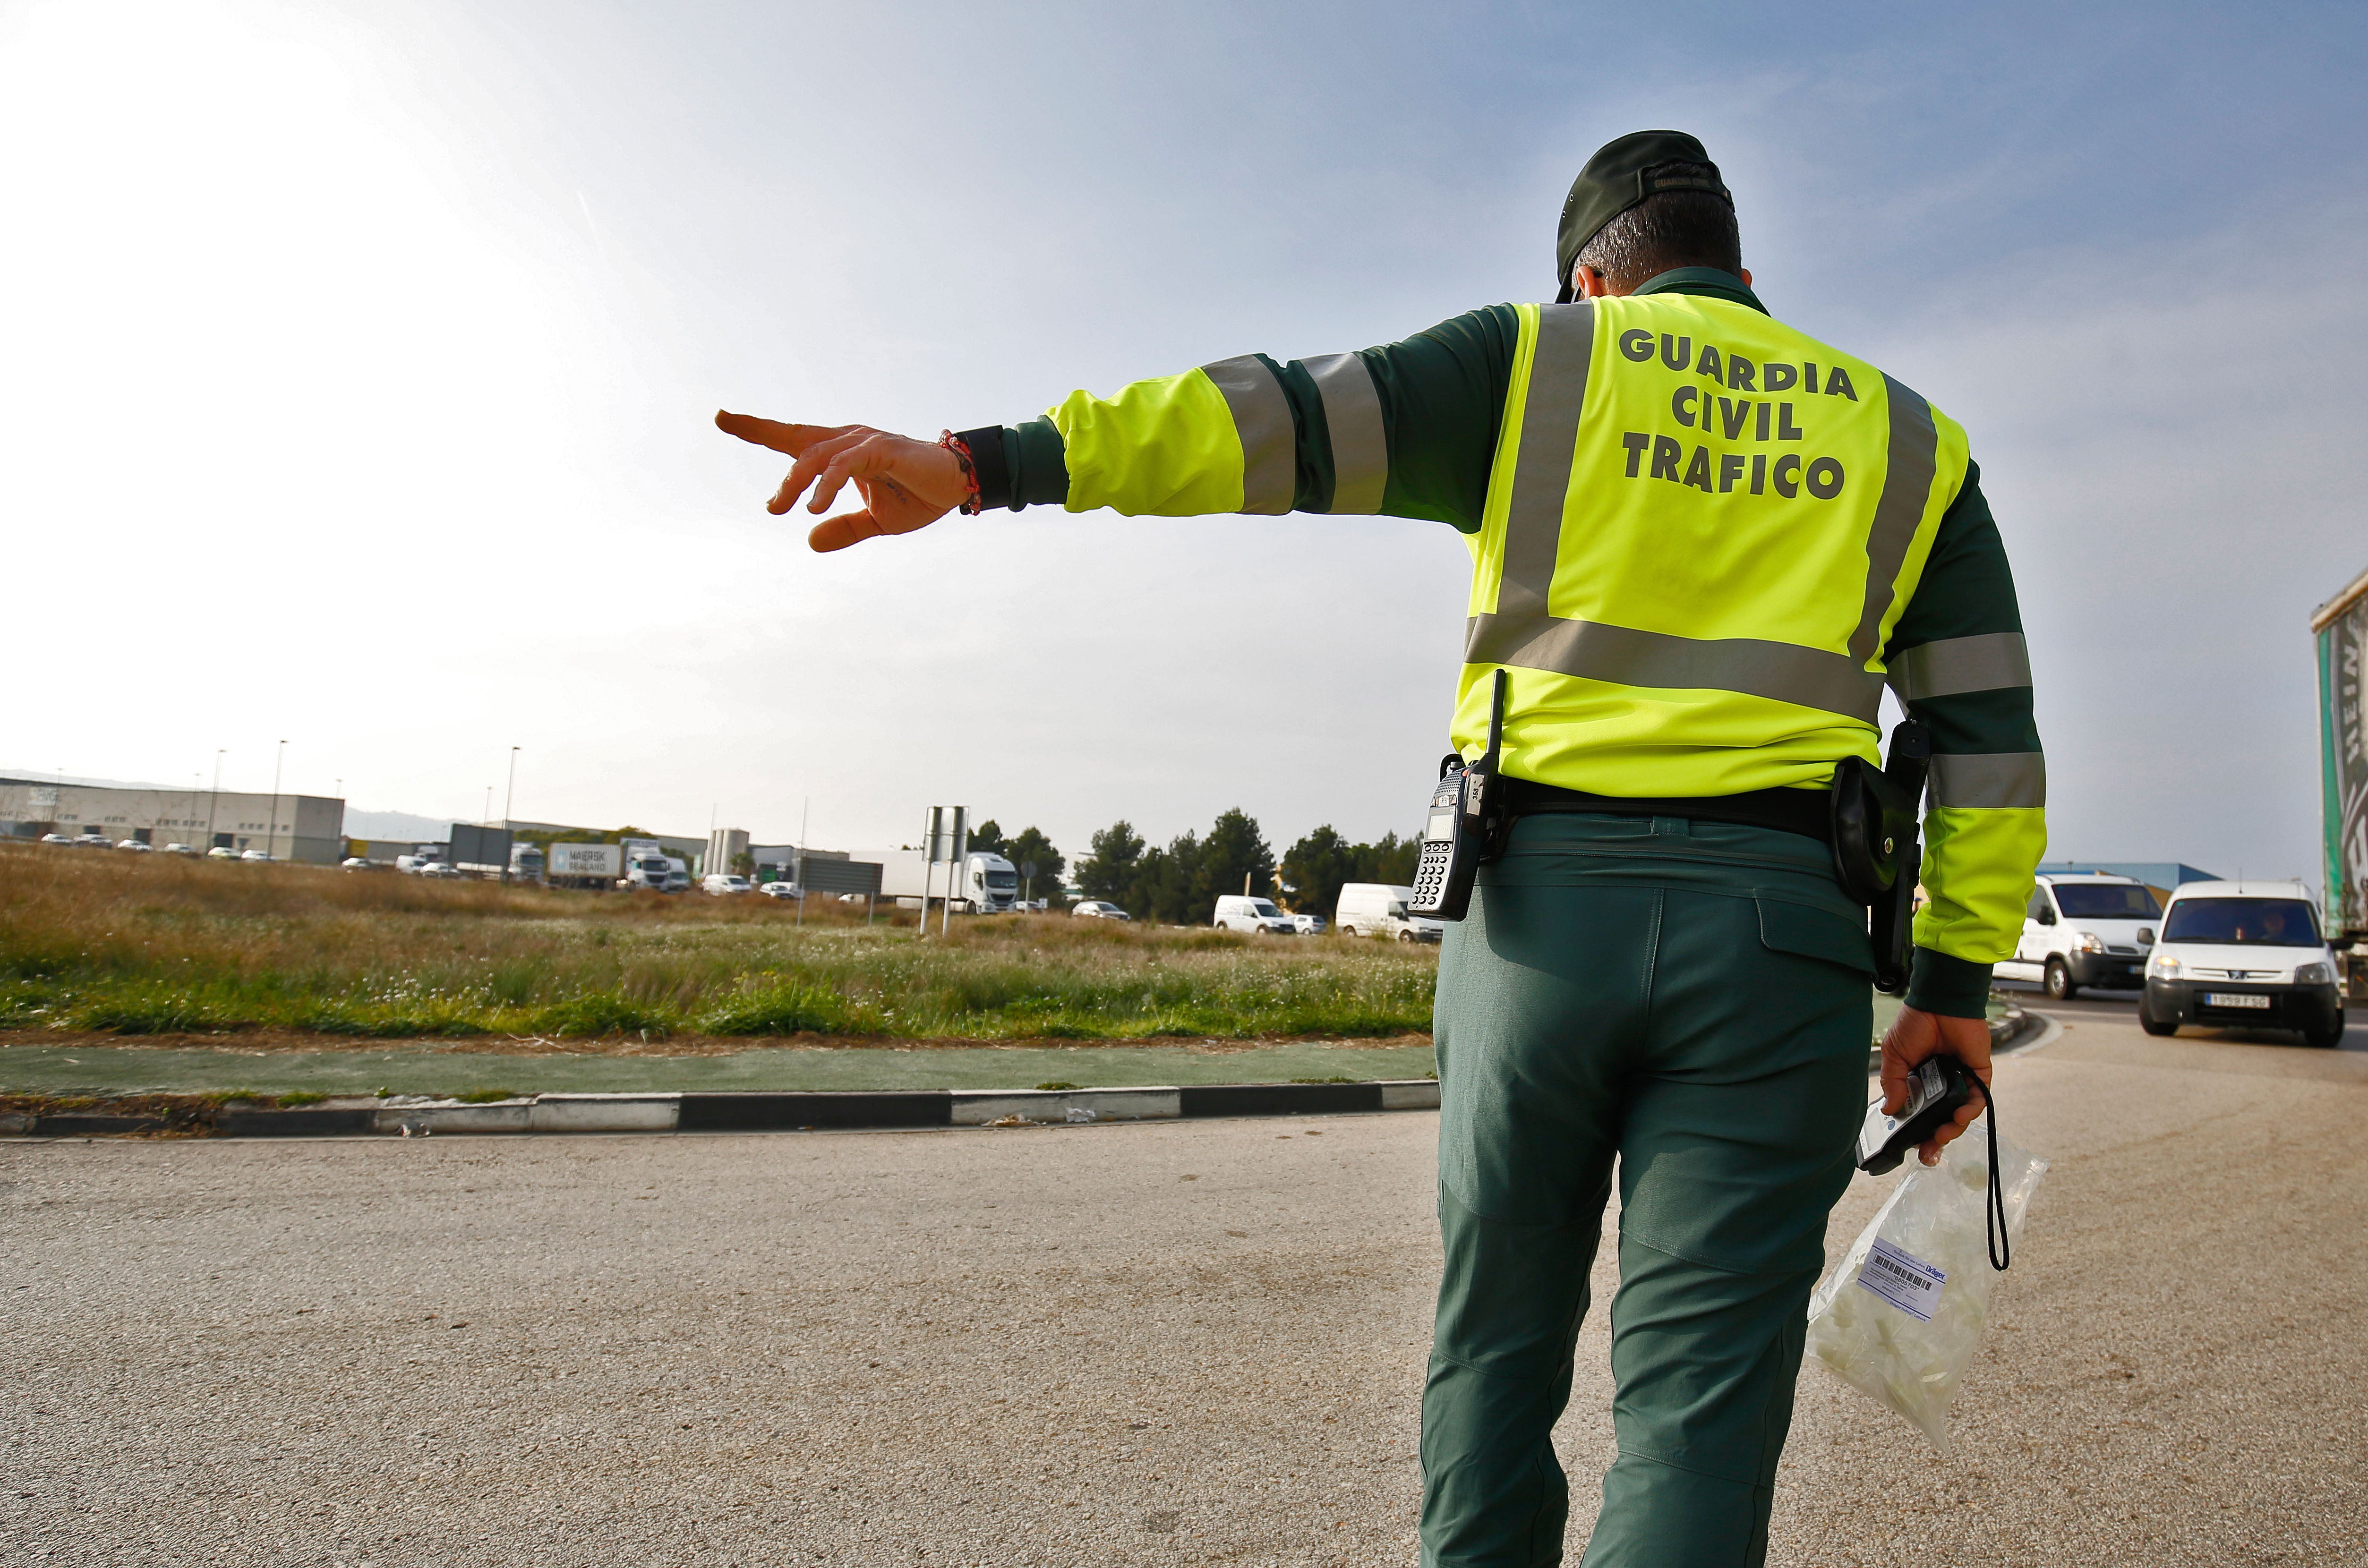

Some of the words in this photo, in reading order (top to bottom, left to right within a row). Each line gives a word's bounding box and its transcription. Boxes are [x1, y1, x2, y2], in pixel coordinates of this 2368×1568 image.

[1655, 177, 1691, 188] GUARDIA
[1619, 329, 1859, 402] GUARDIA
[1671, 385, 1803, 442] CIVIL
[1622, 432, 1845, 500] TRAFICO
[569, 850, 605, 861] MAERSK
[1925, 1265, 1945, 1280] Dräger
